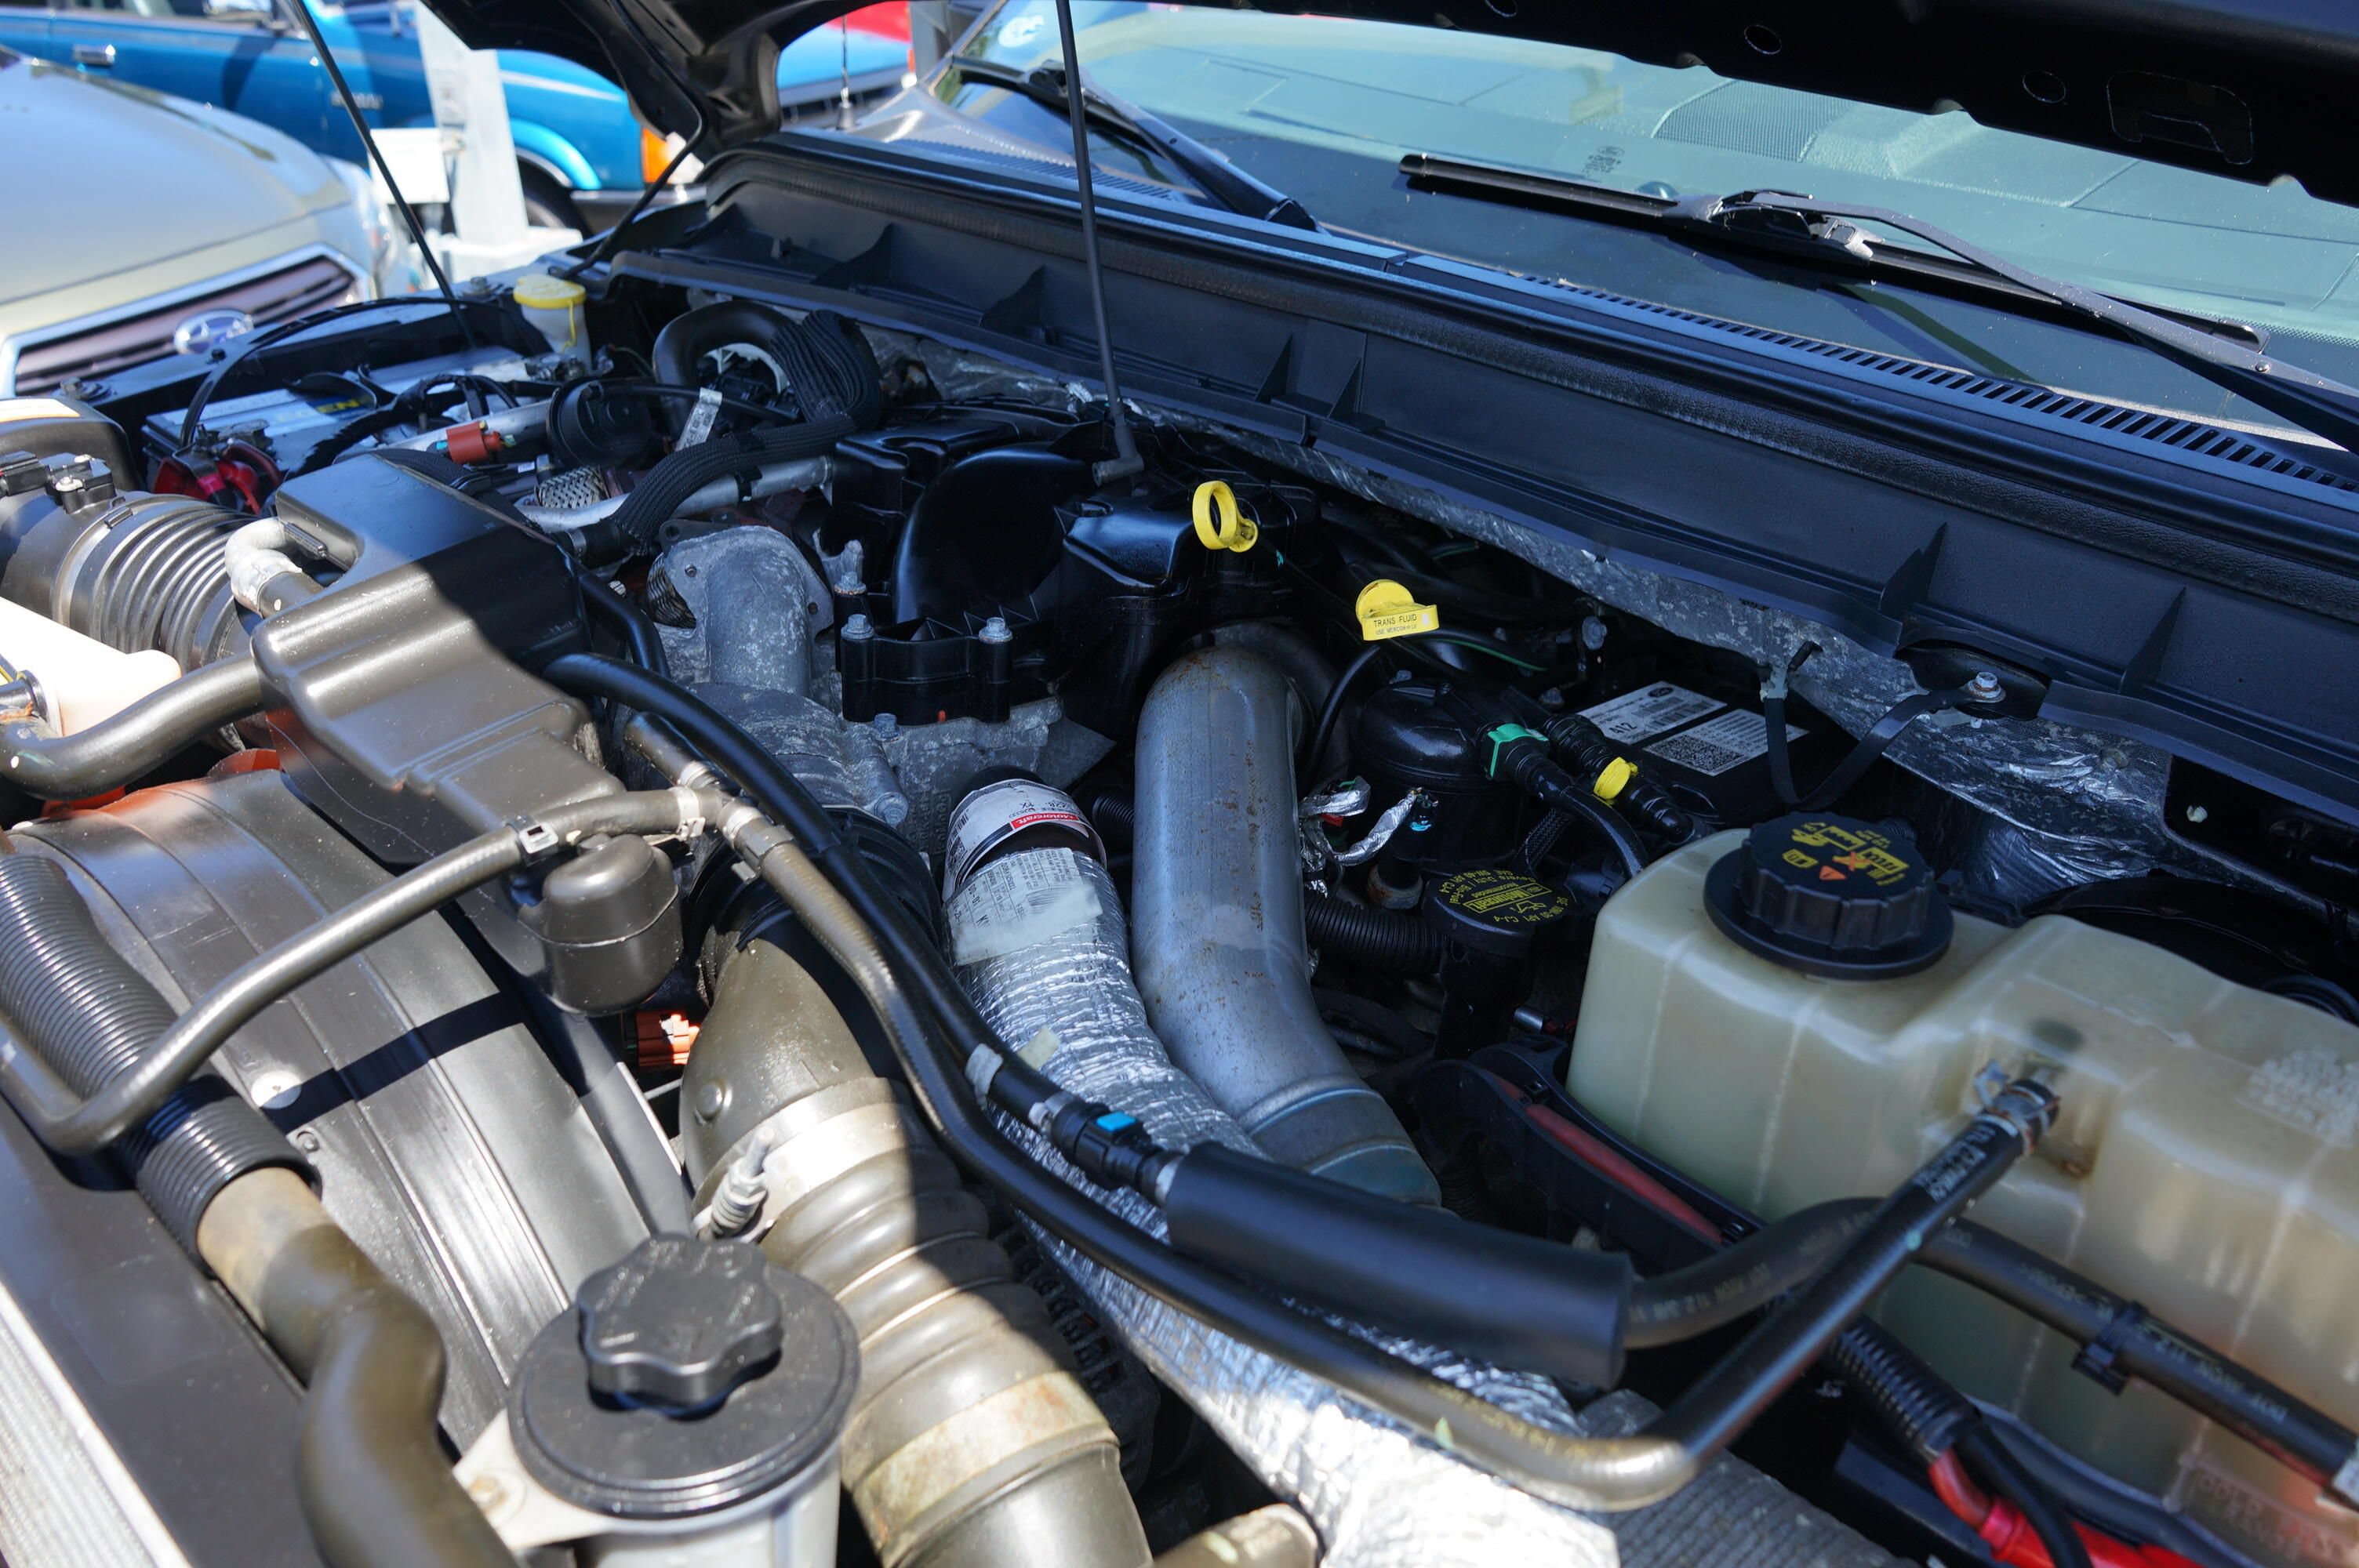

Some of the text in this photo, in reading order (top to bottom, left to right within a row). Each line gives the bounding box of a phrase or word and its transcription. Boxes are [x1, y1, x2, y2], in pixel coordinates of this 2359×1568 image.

[1374, 614, 1417, 627] TRANS FLUID
[1498, 874, 1537, 883] Severe
[1438, 881, 1456, 894] CJ-4
[1470, 882, 1520, 898] Recommended
[1468, 888, 1531, 910] Motorcraft
[1492, 915, 1520, 924] CJ-4
[1523, 914, 1542, 923] API
